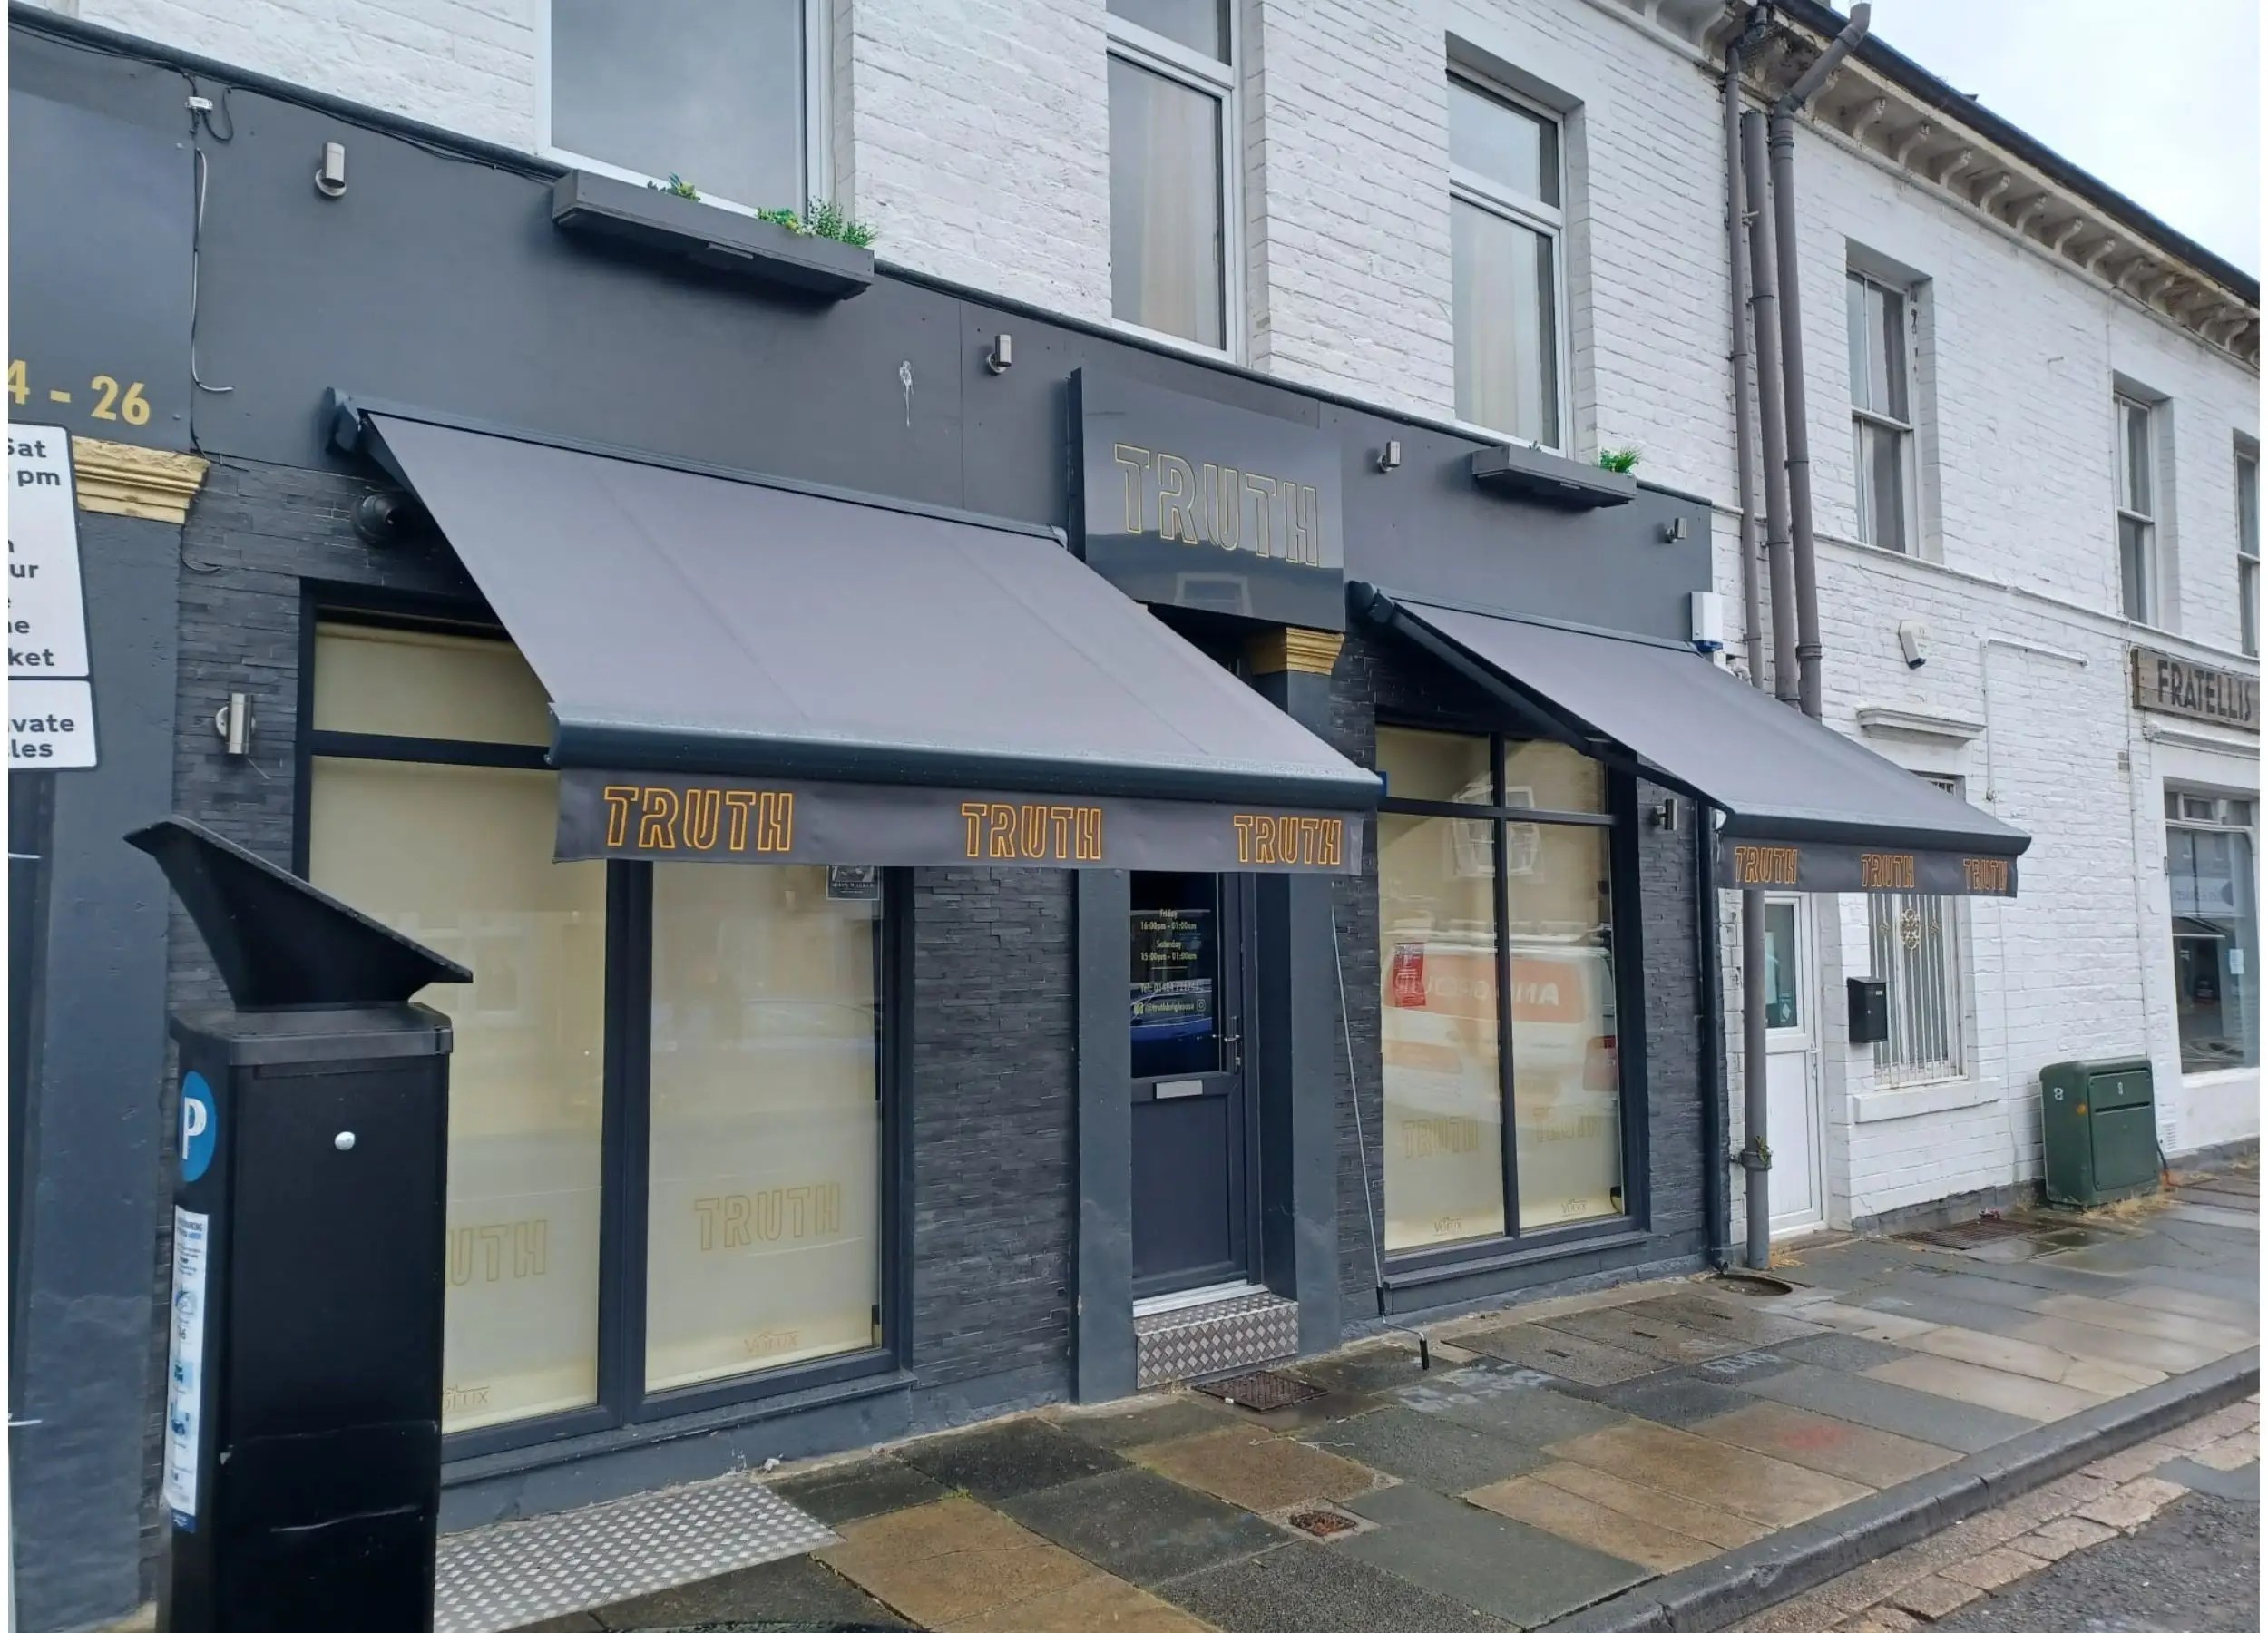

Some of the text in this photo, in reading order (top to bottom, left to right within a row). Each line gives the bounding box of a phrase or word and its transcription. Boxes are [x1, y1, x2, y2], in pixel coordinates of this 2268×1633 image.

[91, 376, 150, 425] 26
[17, 470, 61, 487] pm
[1115, 443, 1319, 567] TRUTH
[2157, 659, 2251, 722] FRATELLIS
[603, 785, 1343, 865] TRUTH TRUTH TRUTH
[1735, 846, 2008, 892] TRUTH TRUTH TRUTH
[182, 1097, 207, 1160] P
[1403, 1116, 1480, 1159] TRUTH
[694, 1183, 841, 1251] TRUTH
